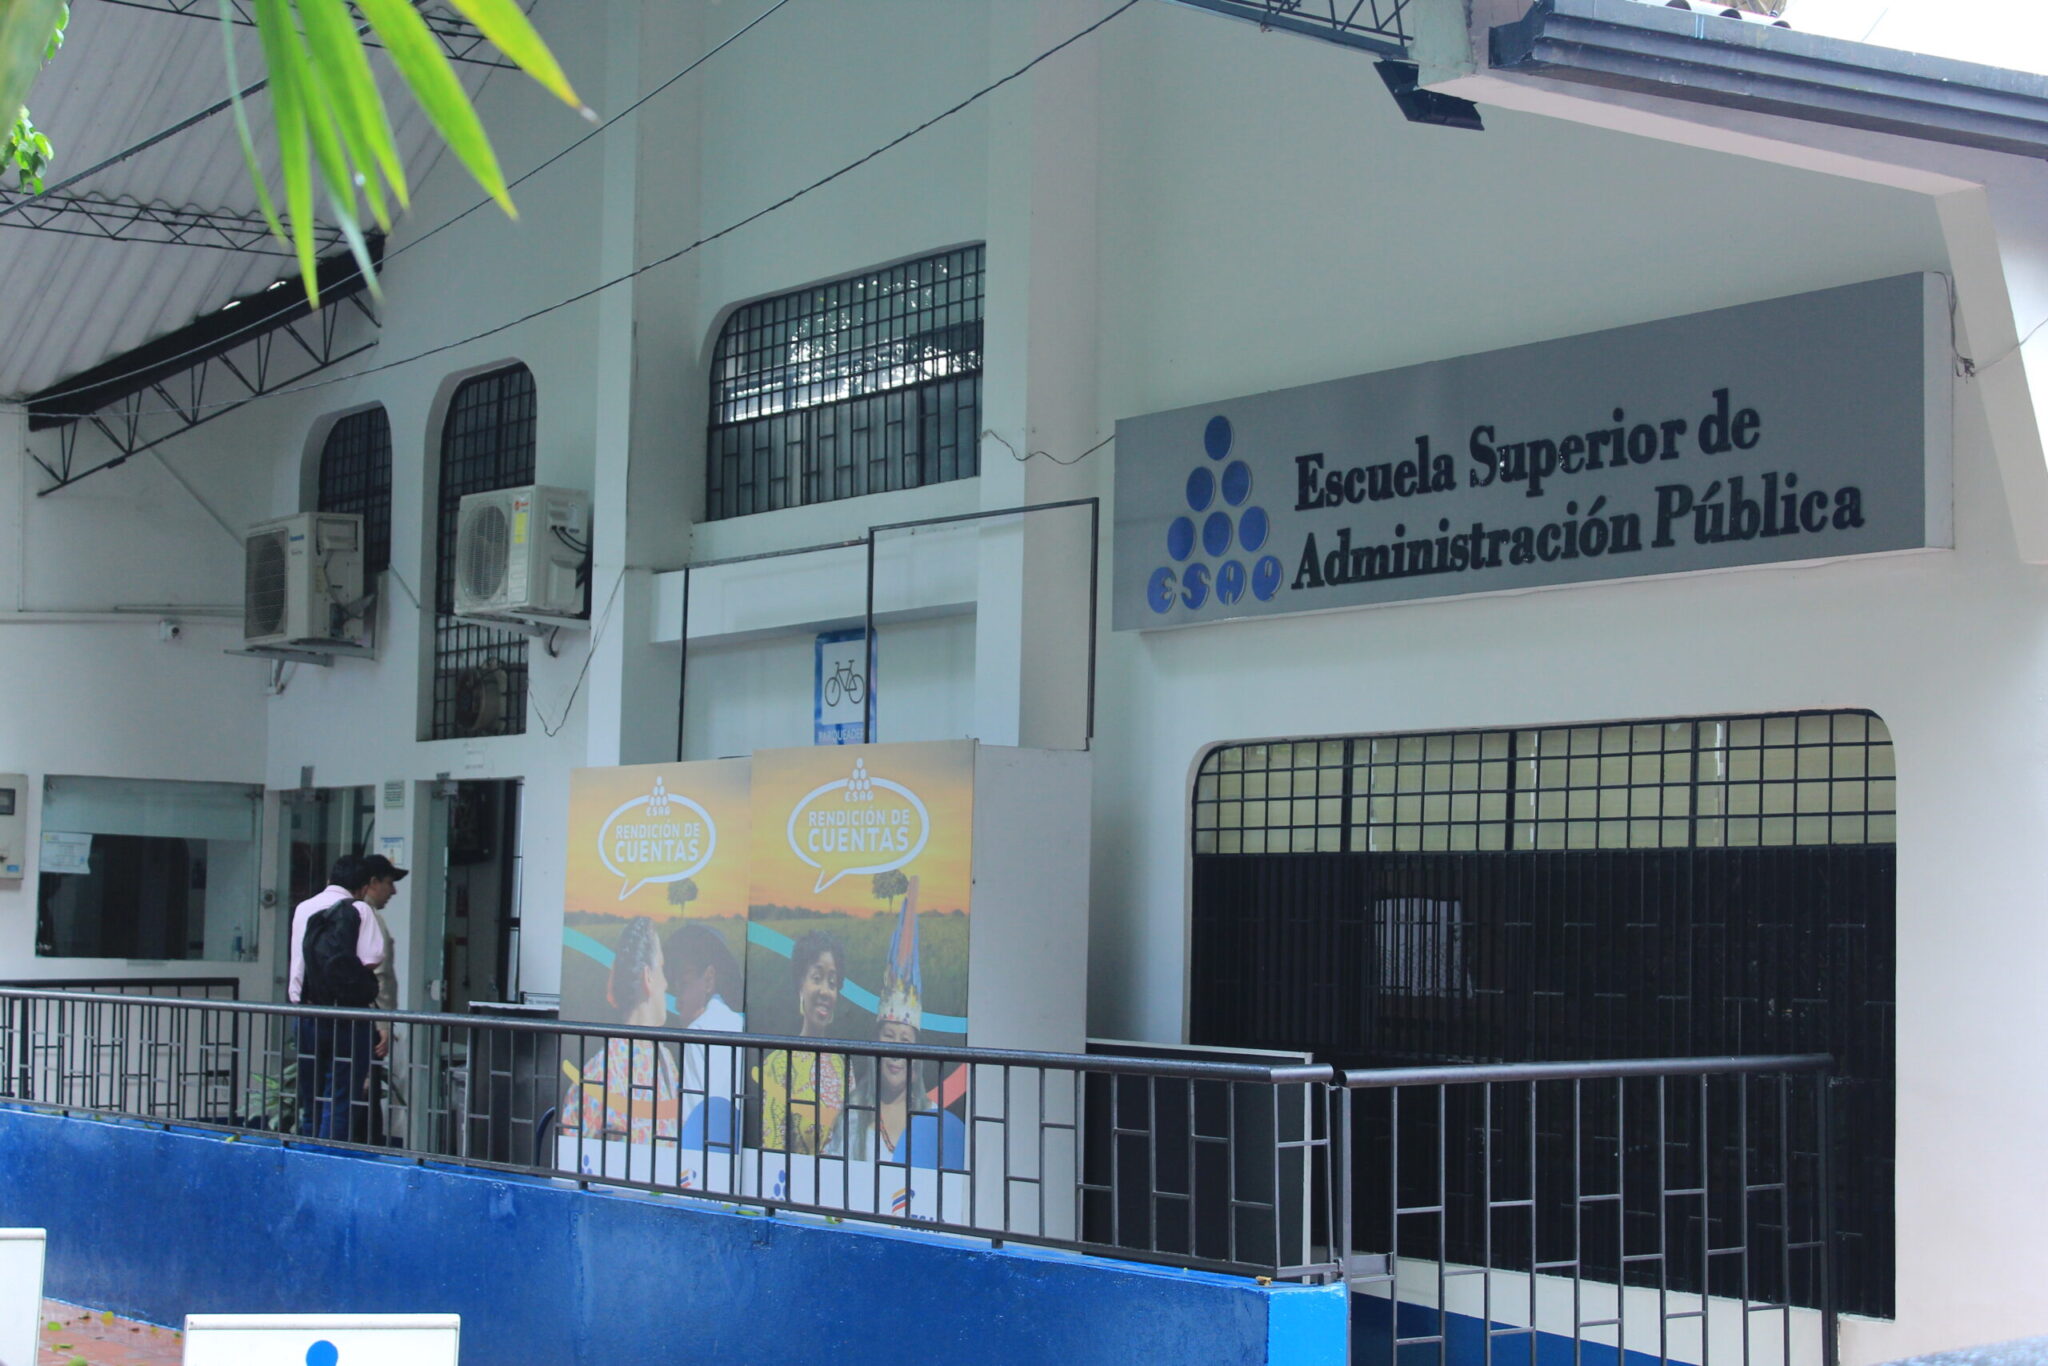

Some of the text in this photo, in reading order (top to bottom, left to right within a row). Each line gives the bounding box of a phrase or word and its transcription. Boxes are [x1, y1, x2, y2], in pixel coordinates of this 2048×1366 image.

[1294, 388, 1761, 511] Escuela Superior de
[1291, 471, 1866, 590] Administración Pública
[809, 805, 910, 826] RENDICIÓN DE
[616, 819, 701, 840] RENDICIÓN DE
[808, 827, 909, 853] CUENTAS
[616, 840, 699, 863] CUENTAS
